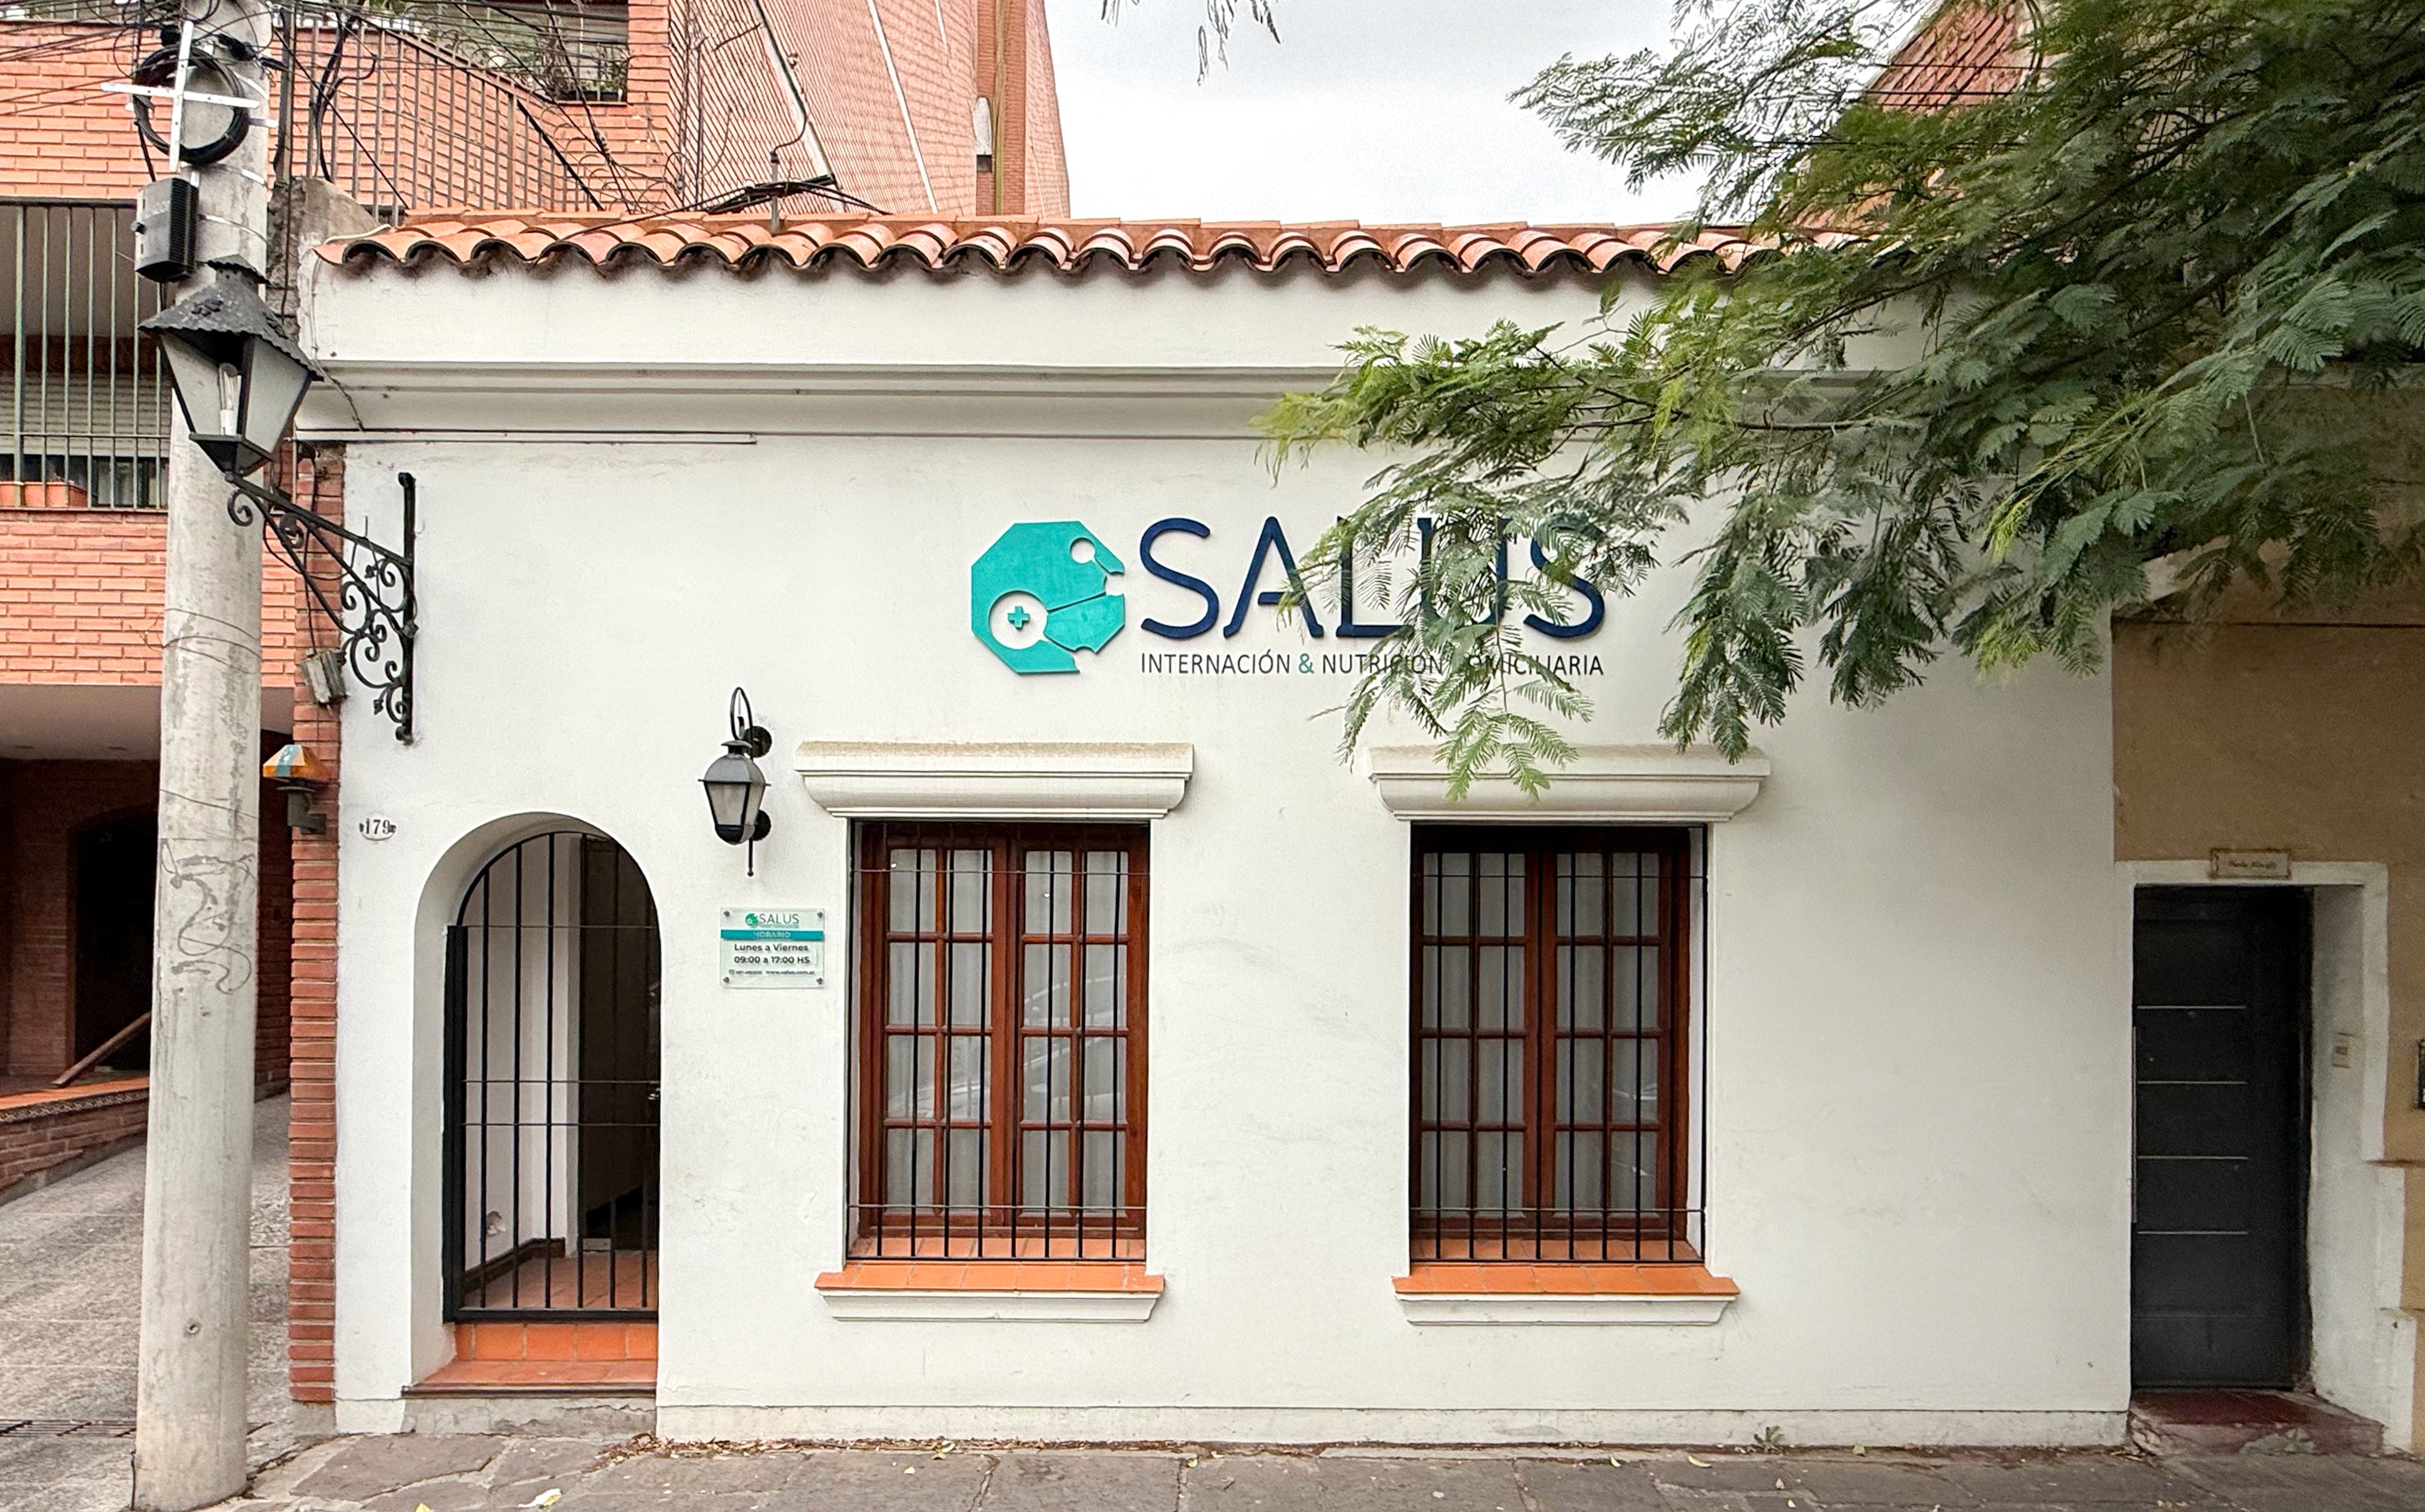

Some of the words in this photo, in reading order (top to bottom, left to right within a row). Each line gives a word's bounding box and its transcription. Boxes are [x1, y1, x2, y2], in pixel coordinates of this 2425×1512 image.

[1139, 516, 1604, 639] SALUS
[1141, 648, 1290, 674] INTERNACIÓN
[1298, 652, 1314, 674] &
[365, 818, 390, 835] 179
[759, 913, 800, 924] SALUS
[734, 943, 763, 951] Lunes
[773, 943, 809, 951] Viernes
[734, 956, 760, 964] 09:00
[770, 956, 795, 964] 17:00
[797, 956, 811, 964] HS
